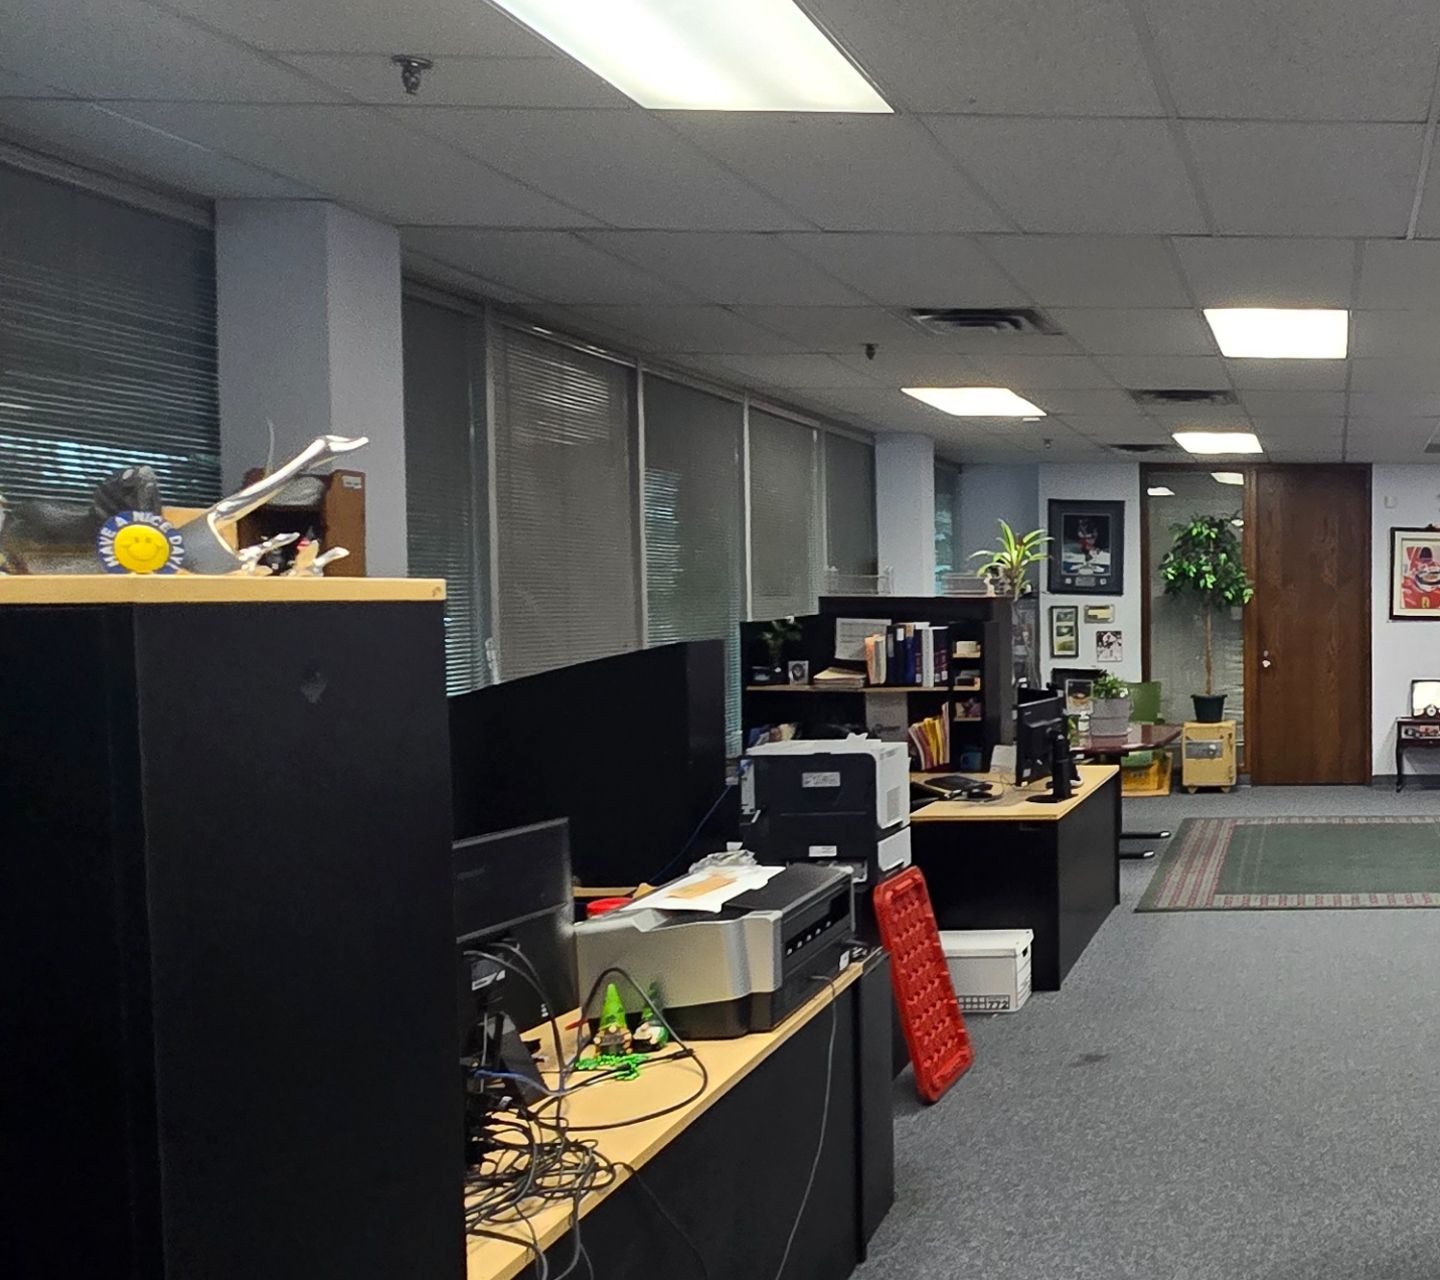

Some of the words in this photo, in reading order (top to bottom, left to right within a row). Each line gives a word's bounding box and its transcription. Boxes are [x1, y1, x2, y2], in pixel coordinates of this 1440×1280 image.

[99, 527, 118, 567] HAVE
[115, 516, 128, 527] A
[132, 511, 172, 533] NICE
[988, 1001, 1008, 1009] 772
